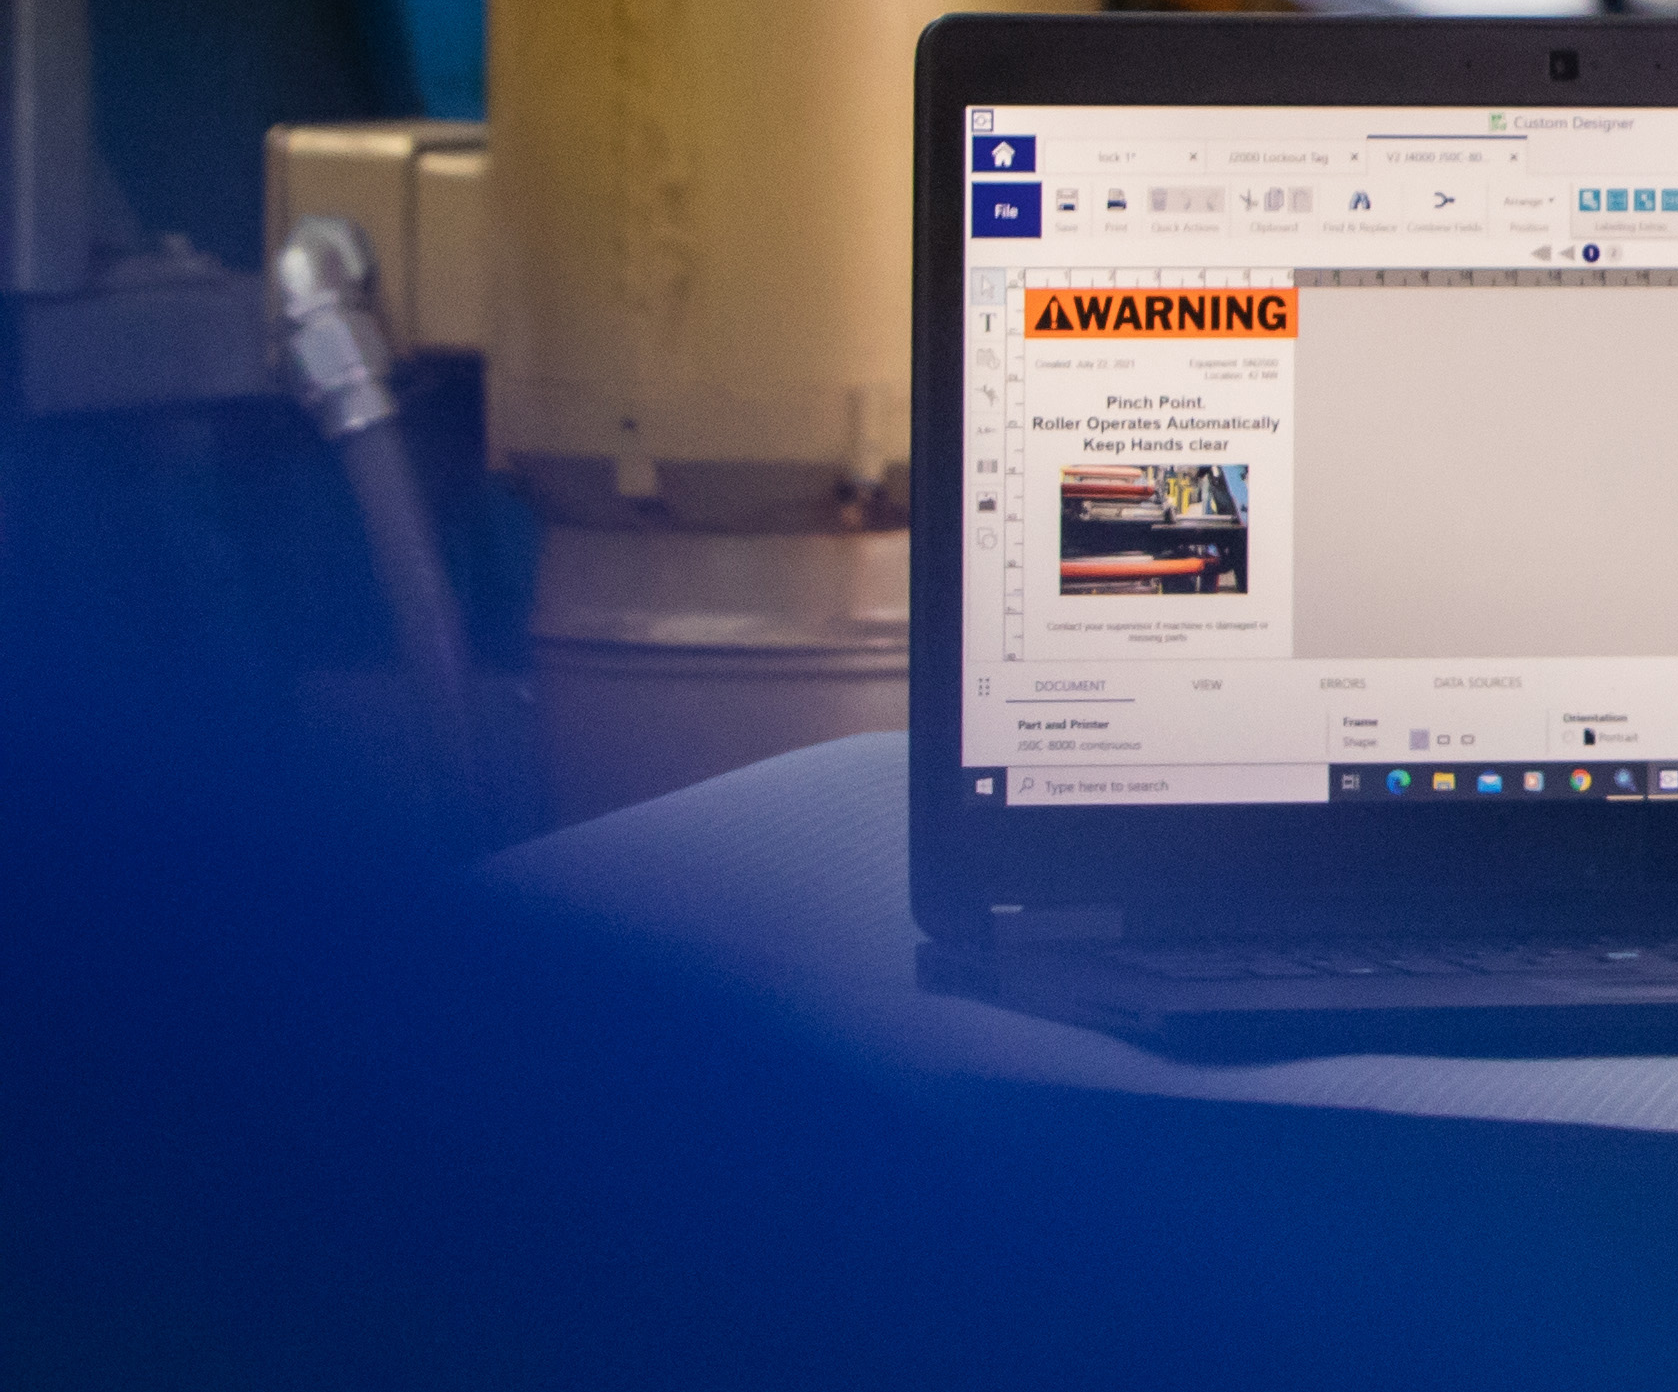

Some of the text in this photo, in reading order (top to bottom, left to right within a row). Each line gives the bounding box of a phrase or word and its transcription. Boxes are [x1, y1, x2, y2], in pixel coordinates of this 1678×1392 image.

[1513, 116, 1634, 133] Custom Designer
[994, 203, 1019, 220] File
[1073, 294, 1288, 332] WARNING
[1106, 395, 1153, 410] Pinch
[1032, 416, 1280, 434] Roller Operates Automatically
[1082, 437, 1229, 455] Keep Hands clear
[1047, 621, 1082, 631] Contact
[1084, 622, 1103, 632] your
[1106, 621, 1153, 632] supervisor
[1162, 621, 1204, 630] machine
[1215, 620, 1258, 632] damaged
[1127, 633, 1188, 644] missing parts
[1034, 679, 1107, 693] DOCUMENT
[1191, 678, 1224, 692] VIEW
[1319, 677, 1367, 690] ERRORS
[1433, 675, 1523, 690] DATA SOURCES
[1017, 718, 1110, 731] Part and Printer
[1342, 717, 1379, 728] Frame
[1562, 712, 1629, 724] Orientation
[1079, 739, 1142, 751] continuous
[1044, 779, 1169, 795] Type here to search
